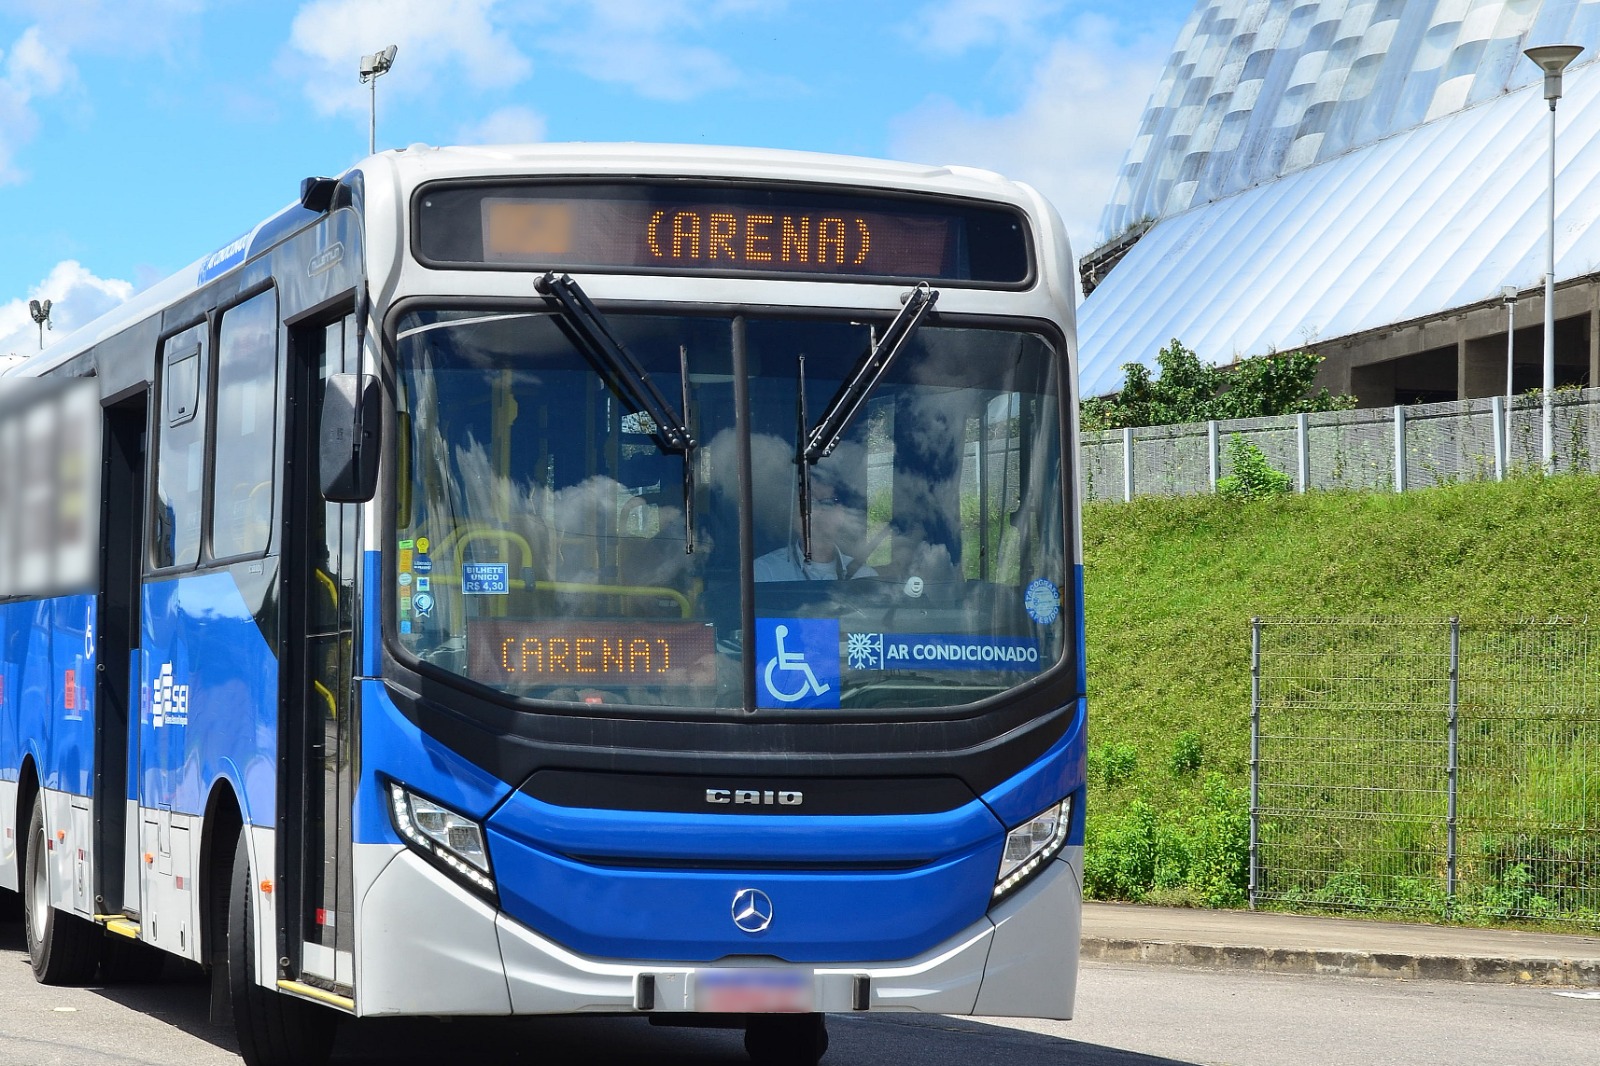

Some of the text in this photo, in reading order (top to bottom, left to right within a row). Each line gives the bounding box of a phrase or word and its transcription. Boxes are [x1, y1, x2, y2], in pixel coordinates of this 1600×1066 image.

[648, 211, 871, 264] (ARENA)
[466, 566, 504, 574] BILHETE
[466, 581, 504, 592] R$ 4,30
[502, 638, 669, 672] (ARENA)
[886, 644, 1038, 662] AR CONDICIONADO
[706, 789, 803, 805] CAIO
